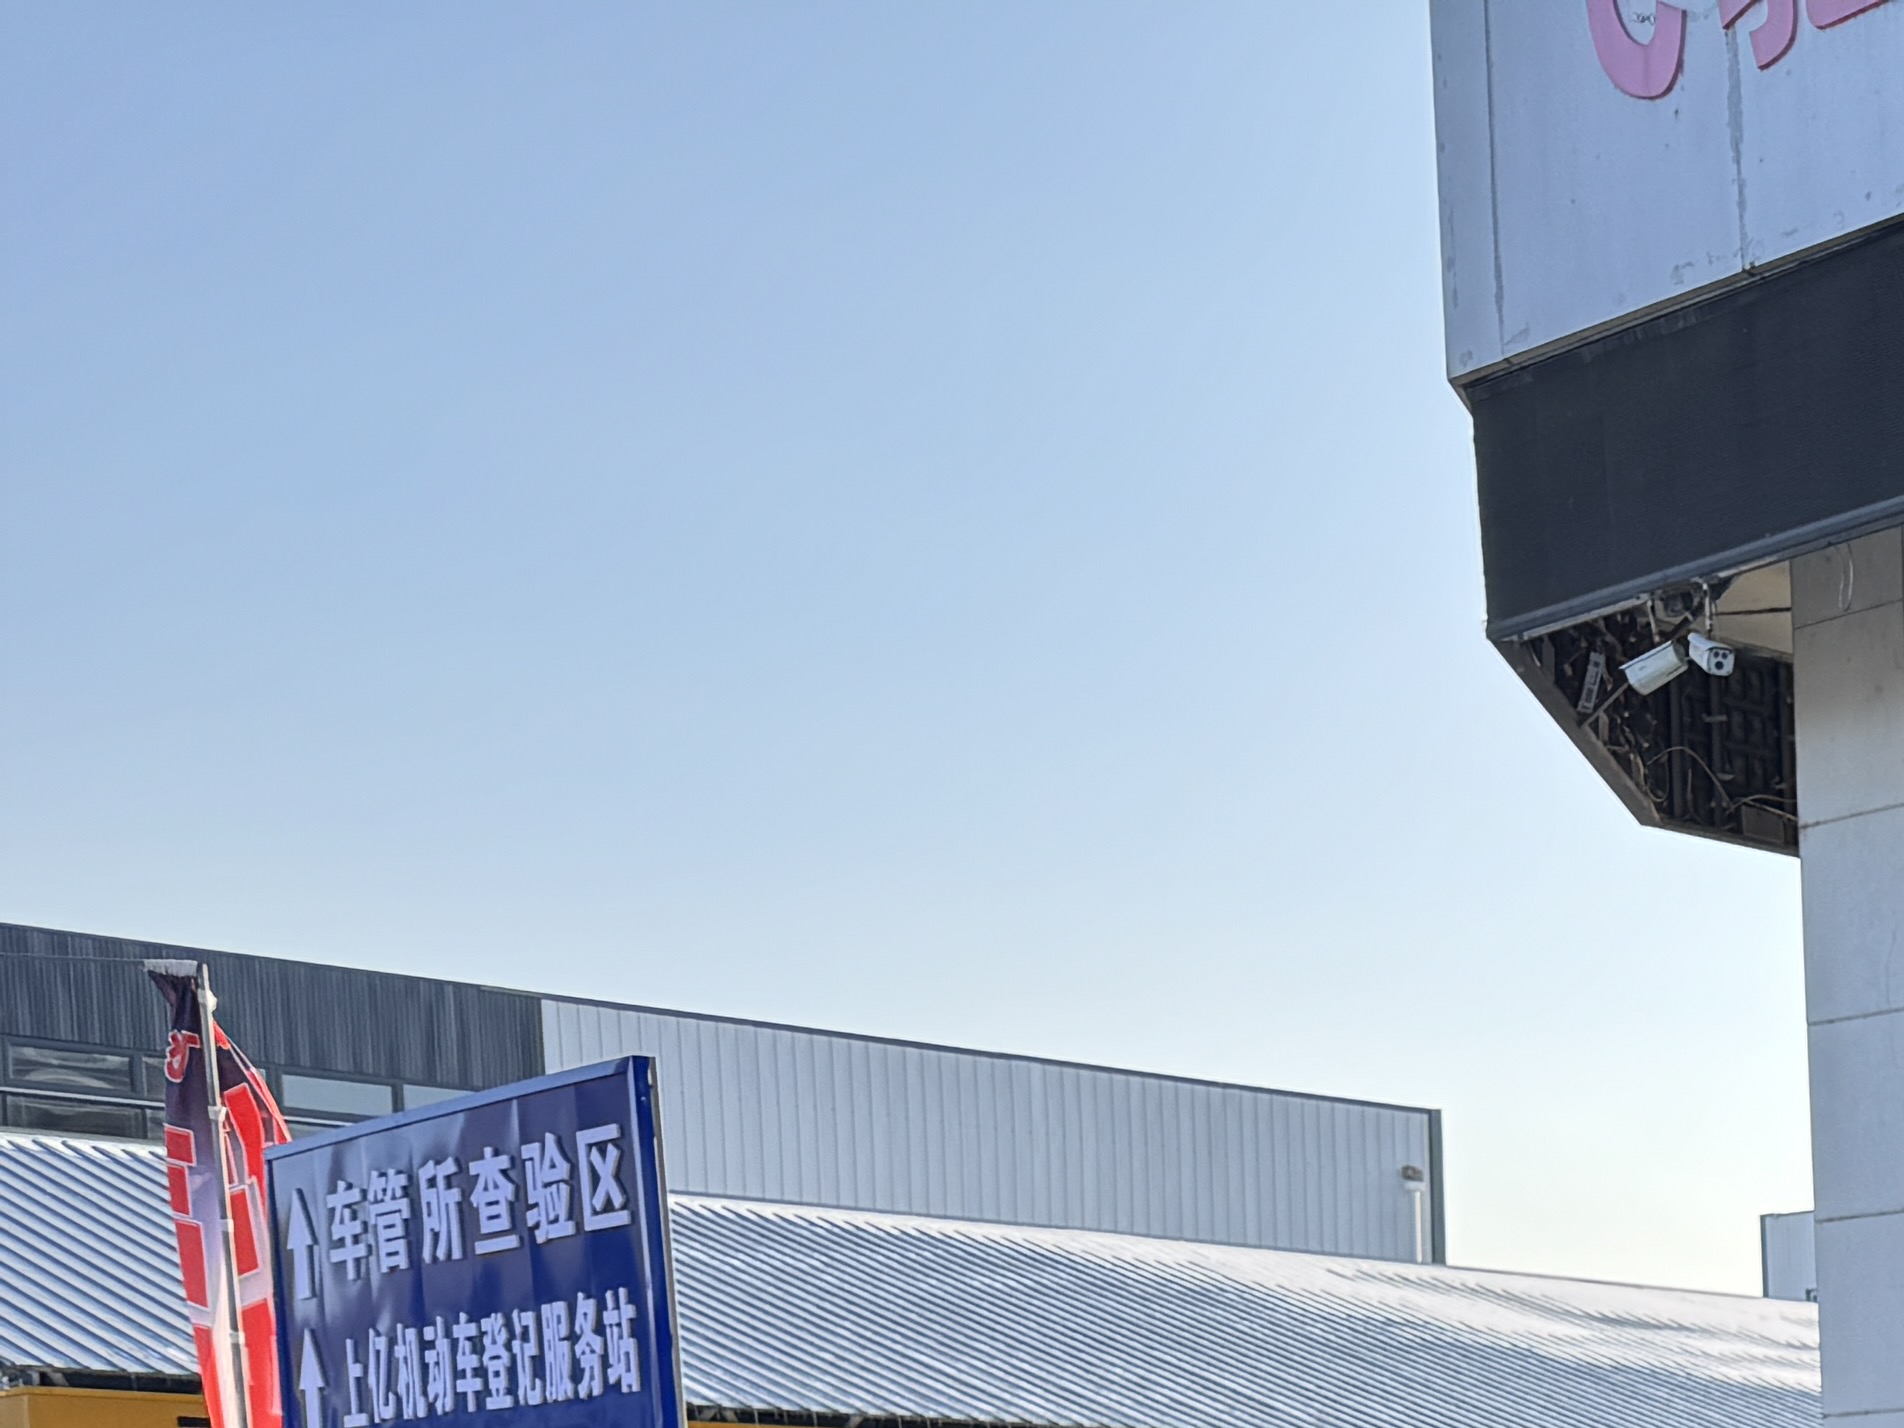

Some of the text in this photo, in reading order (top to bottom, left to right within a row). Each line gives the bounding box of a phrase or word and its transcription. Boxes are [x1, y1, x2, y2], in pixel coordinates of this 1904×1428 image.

[326, 1123, 632, 1281] 车管所查验区
[343, 1287, 641, 1428] 上亿机动车登记服务站
